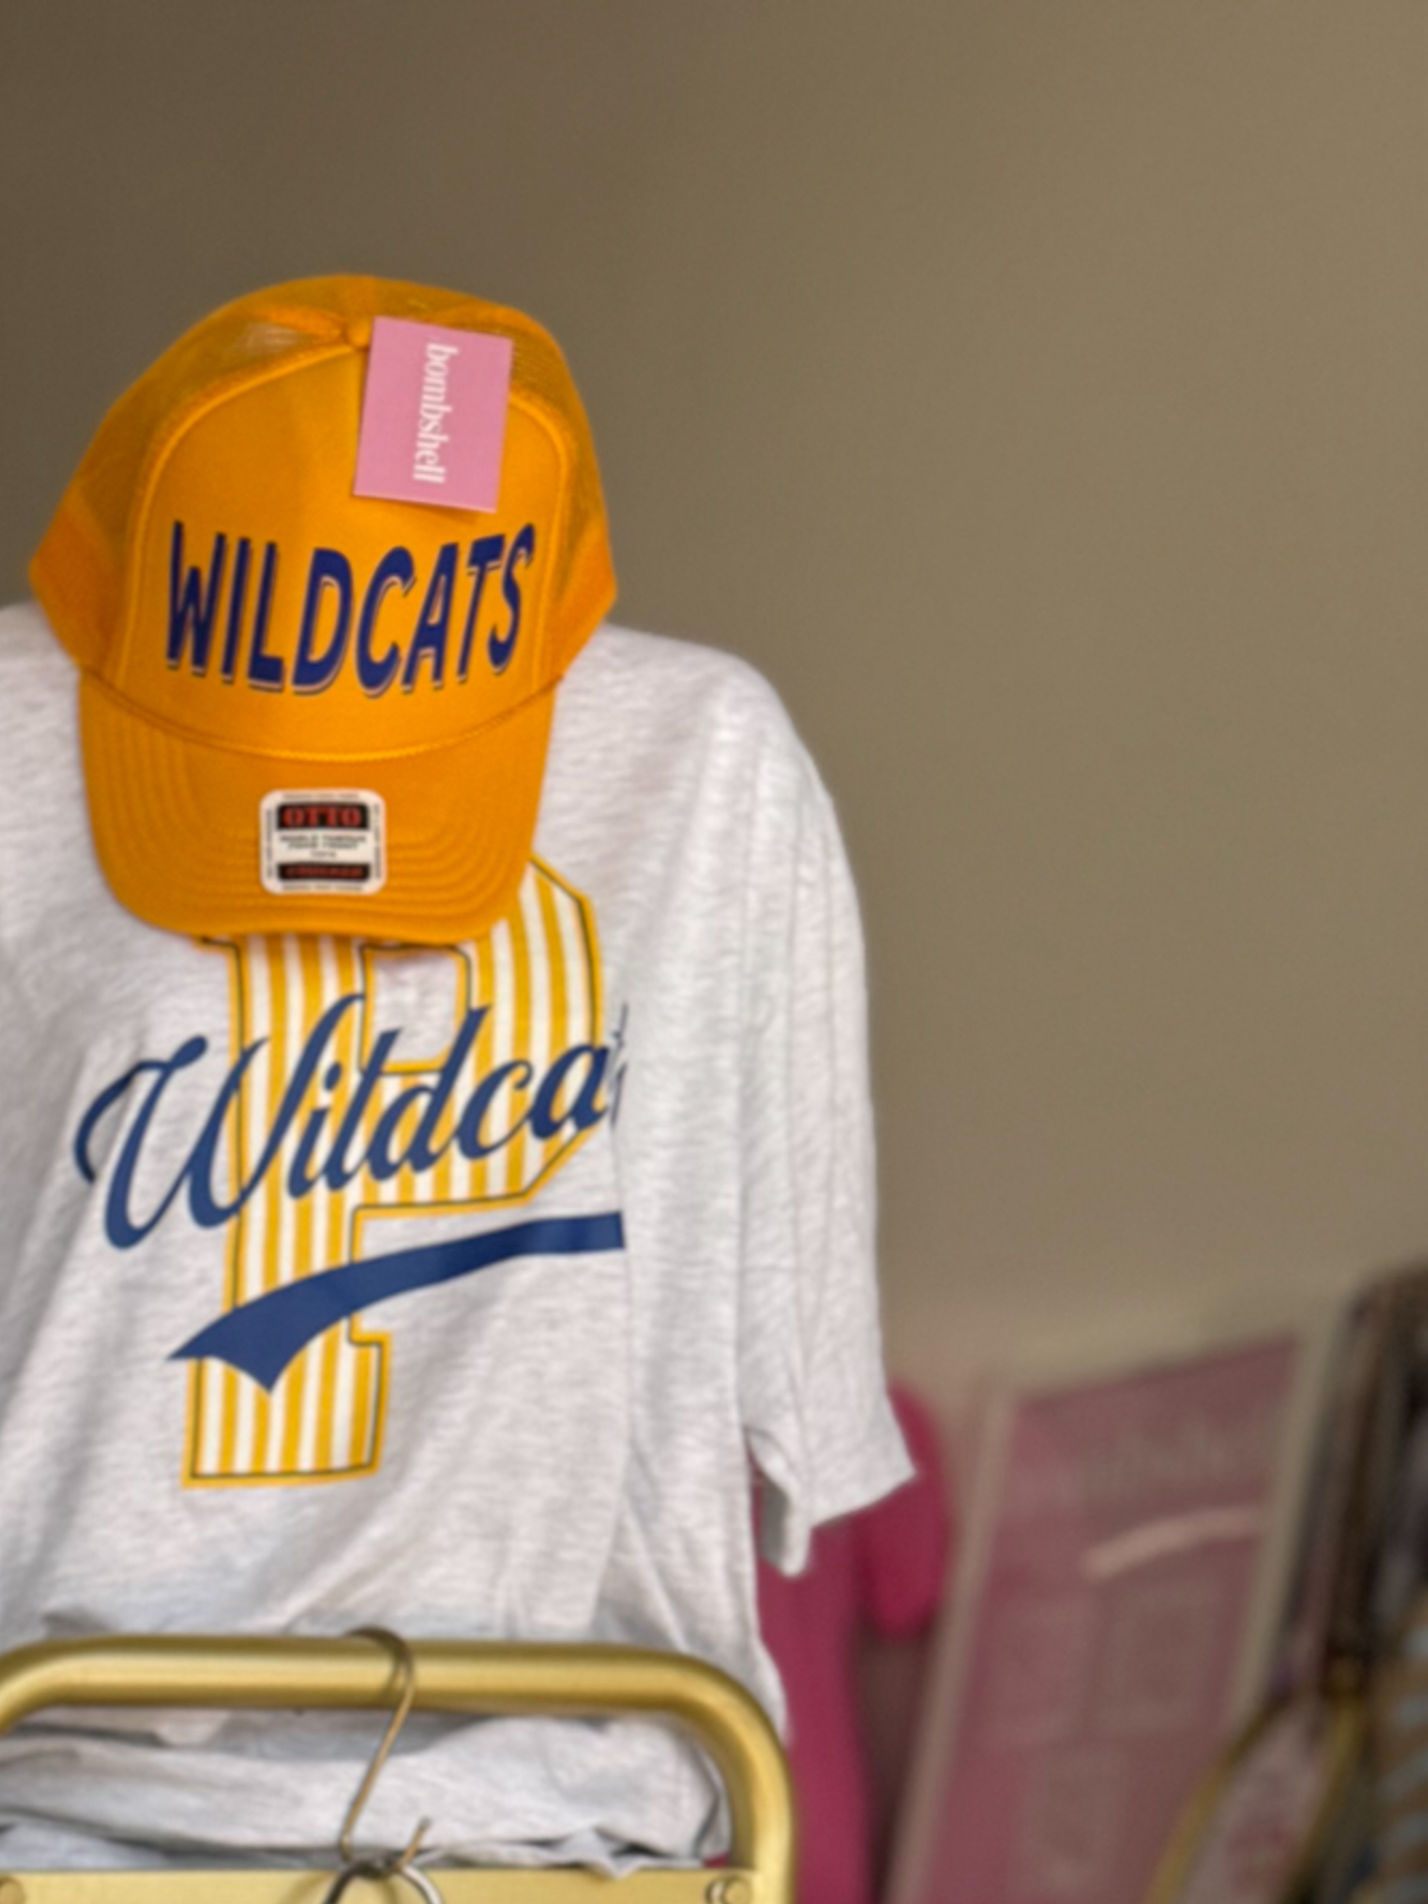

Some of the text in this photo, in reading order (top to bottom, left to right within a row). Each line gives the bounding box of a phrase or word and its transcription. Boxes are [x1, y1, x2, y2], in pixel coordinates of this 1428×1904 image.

[412, 340, 460, 485] bombshell
[166, 520, 538, 701] WILDCATS
[74, 992, 628, 1251] Wildca
